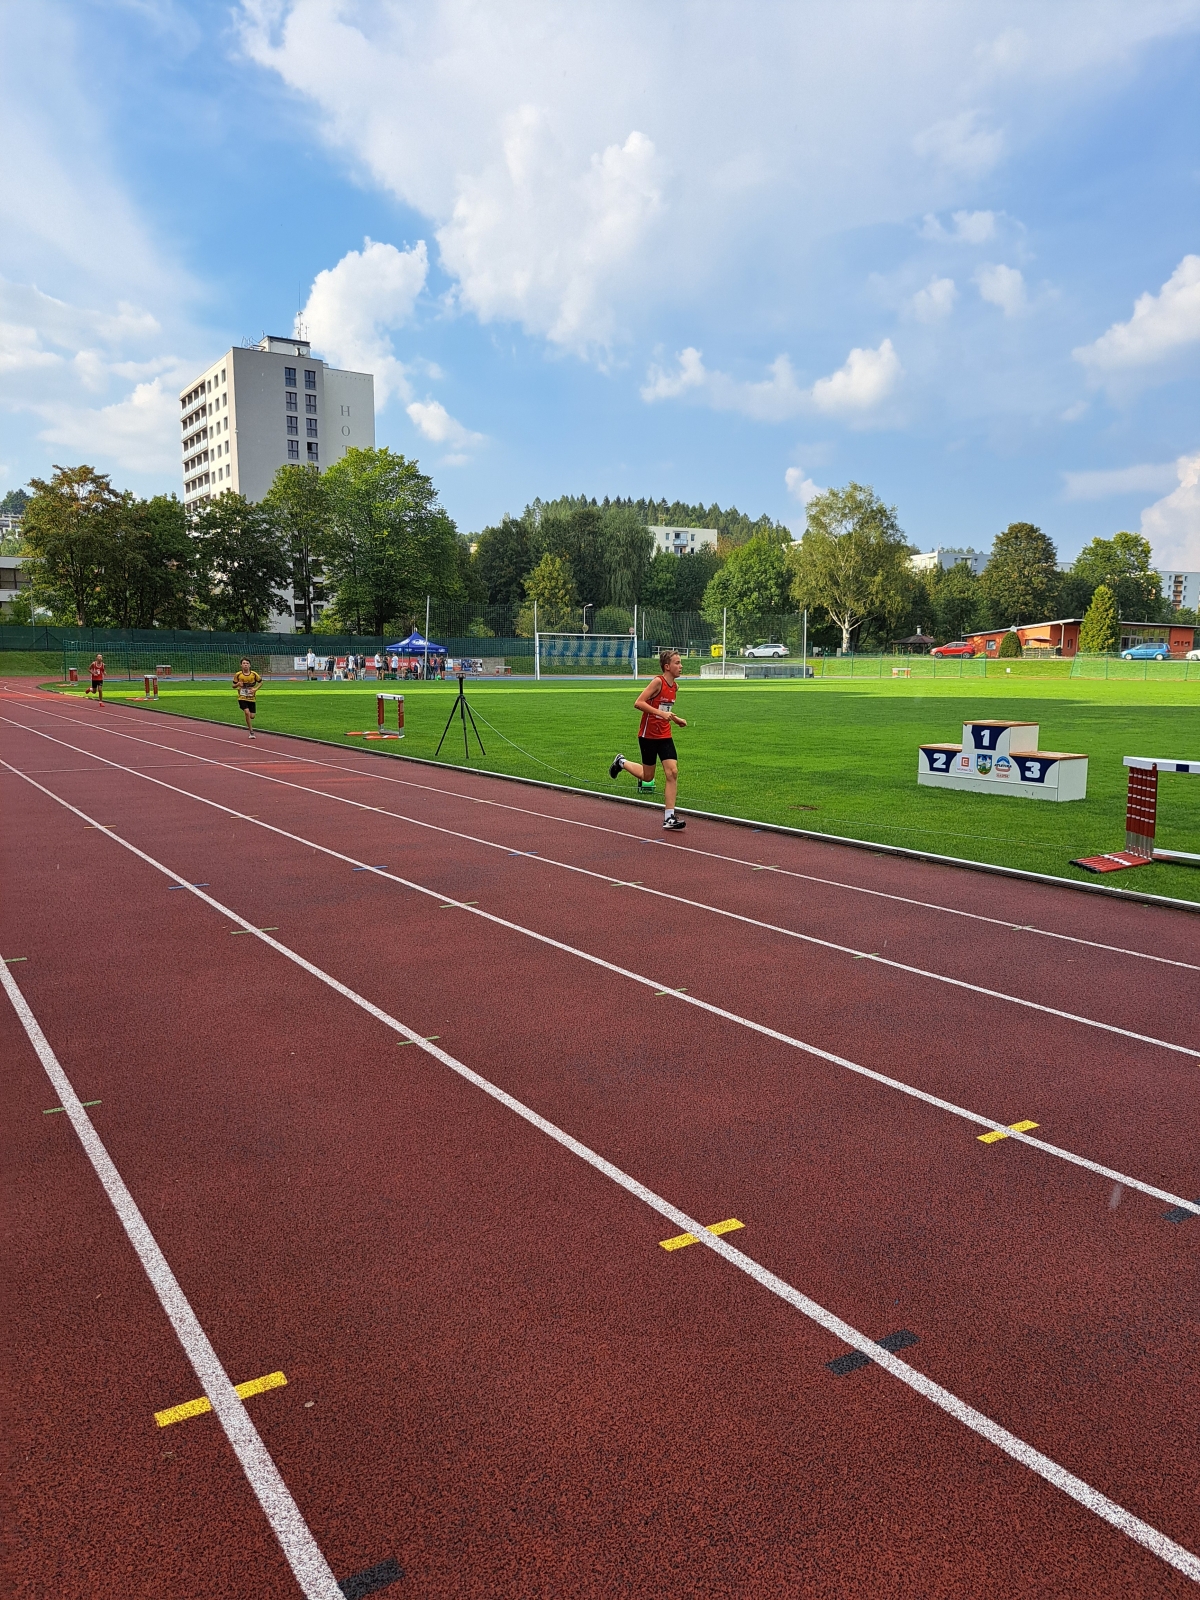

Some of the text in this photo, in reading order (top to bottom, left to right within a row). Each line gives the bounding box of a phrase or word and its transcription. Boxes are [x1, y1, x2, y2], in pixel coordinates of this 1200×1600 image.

[980, 729, 990, 746] 1
[932, 753, 947, 769] 2
[1025, 762, 1041, 778] 3
